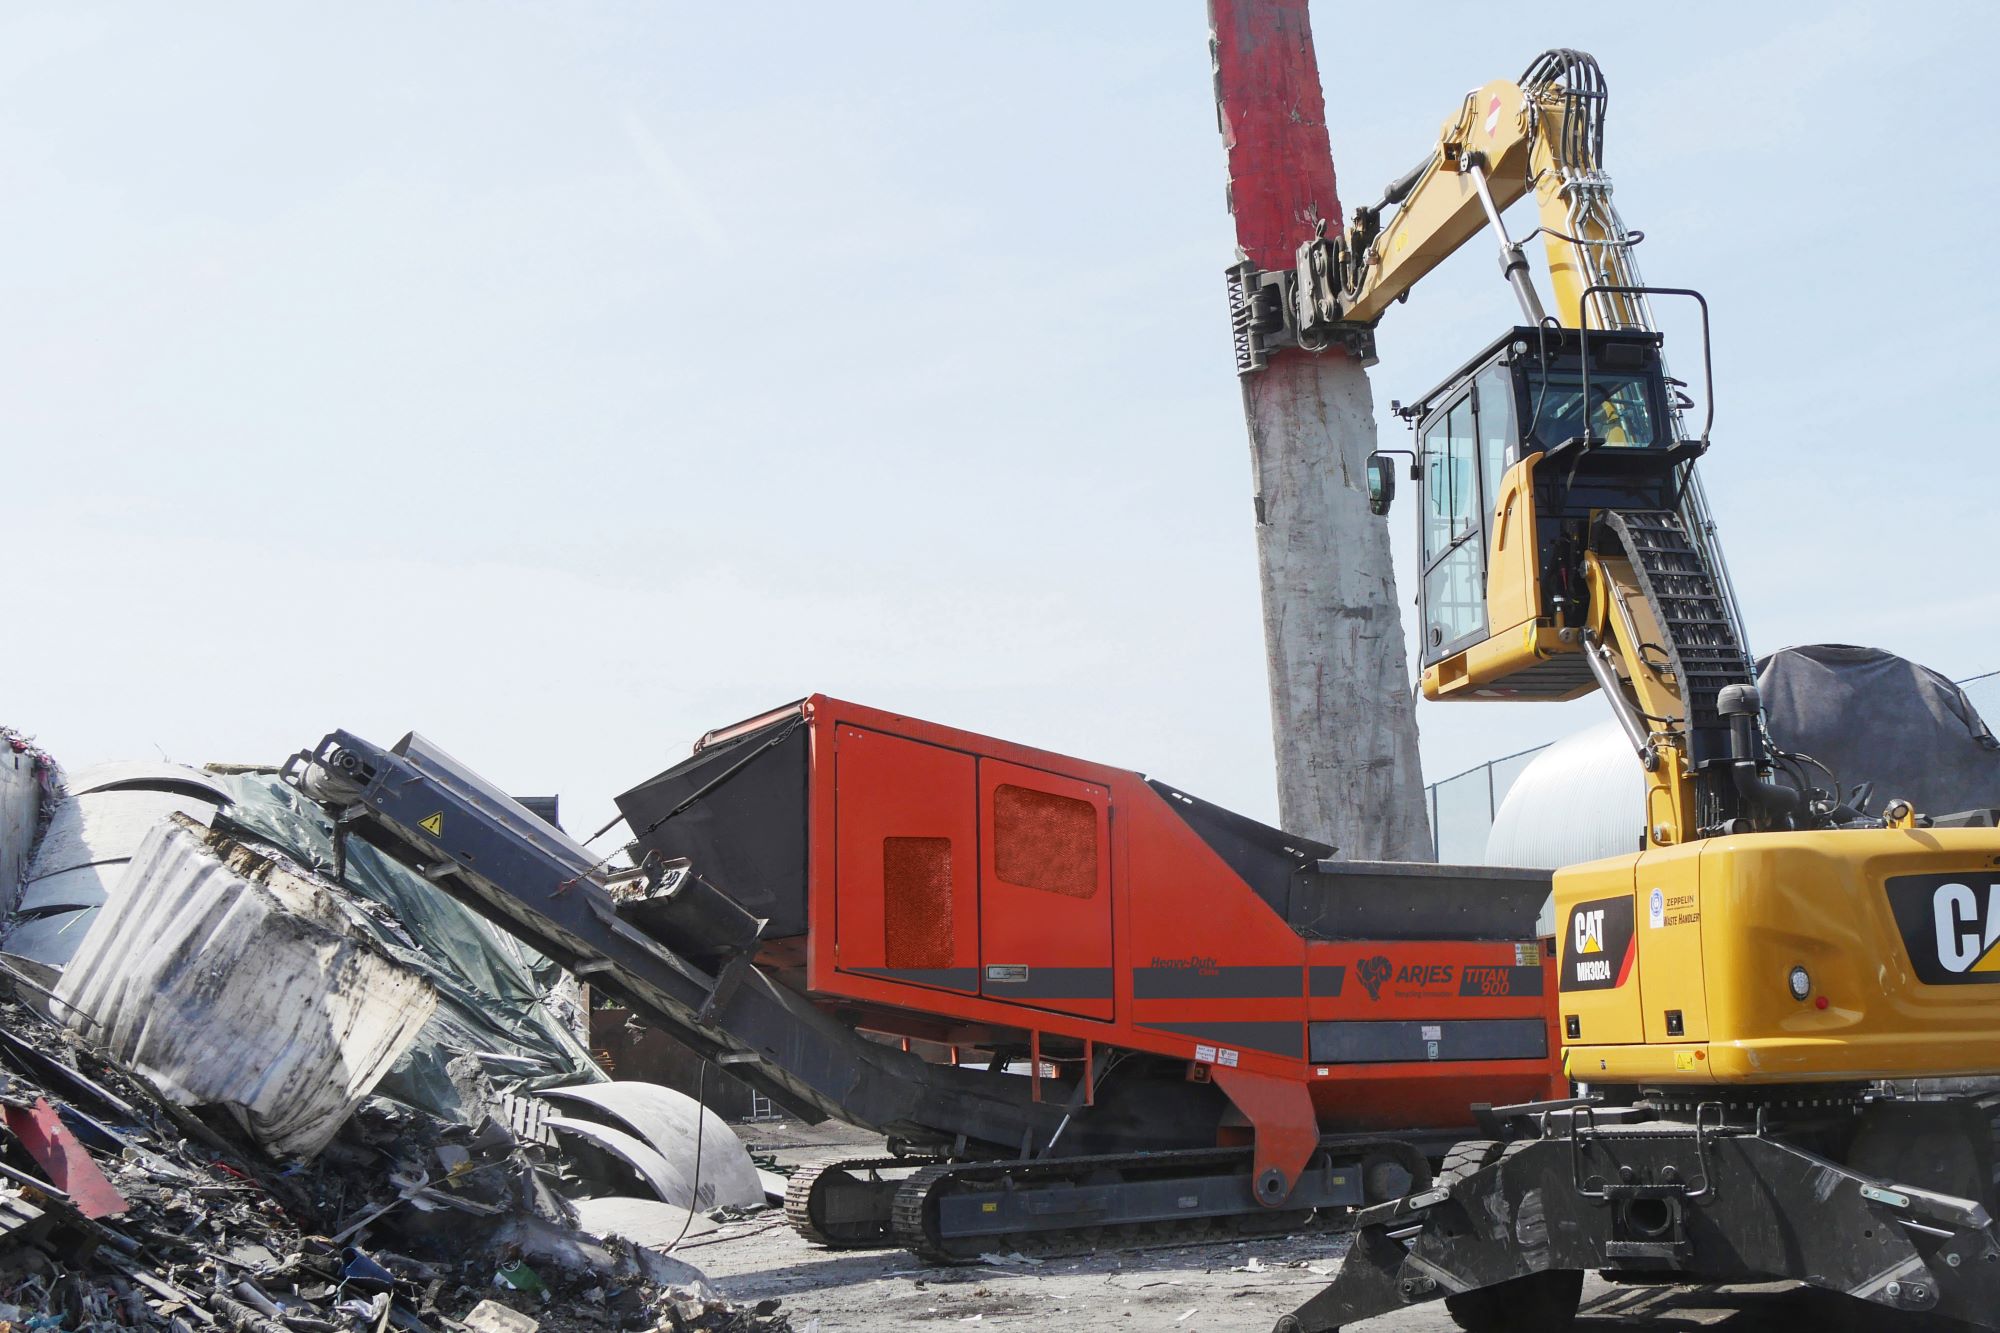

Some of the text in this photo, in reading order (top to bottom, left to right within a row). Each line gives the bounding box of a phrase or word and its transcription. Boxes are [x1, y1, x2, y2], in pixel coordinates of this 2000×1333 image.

[1666, 895, 1694, 907] ZEPPELIN
[1678, 912, 1700, 925] HANDLER
[1574, 909, 1605, 954] CAT
[1395, 965, 1454, 987] ARJES
[1465, 968, 1510, 984] TITAN
[1576, 960, 1611, 982] MH3024
[1481, 982, 1510, 996] 900
